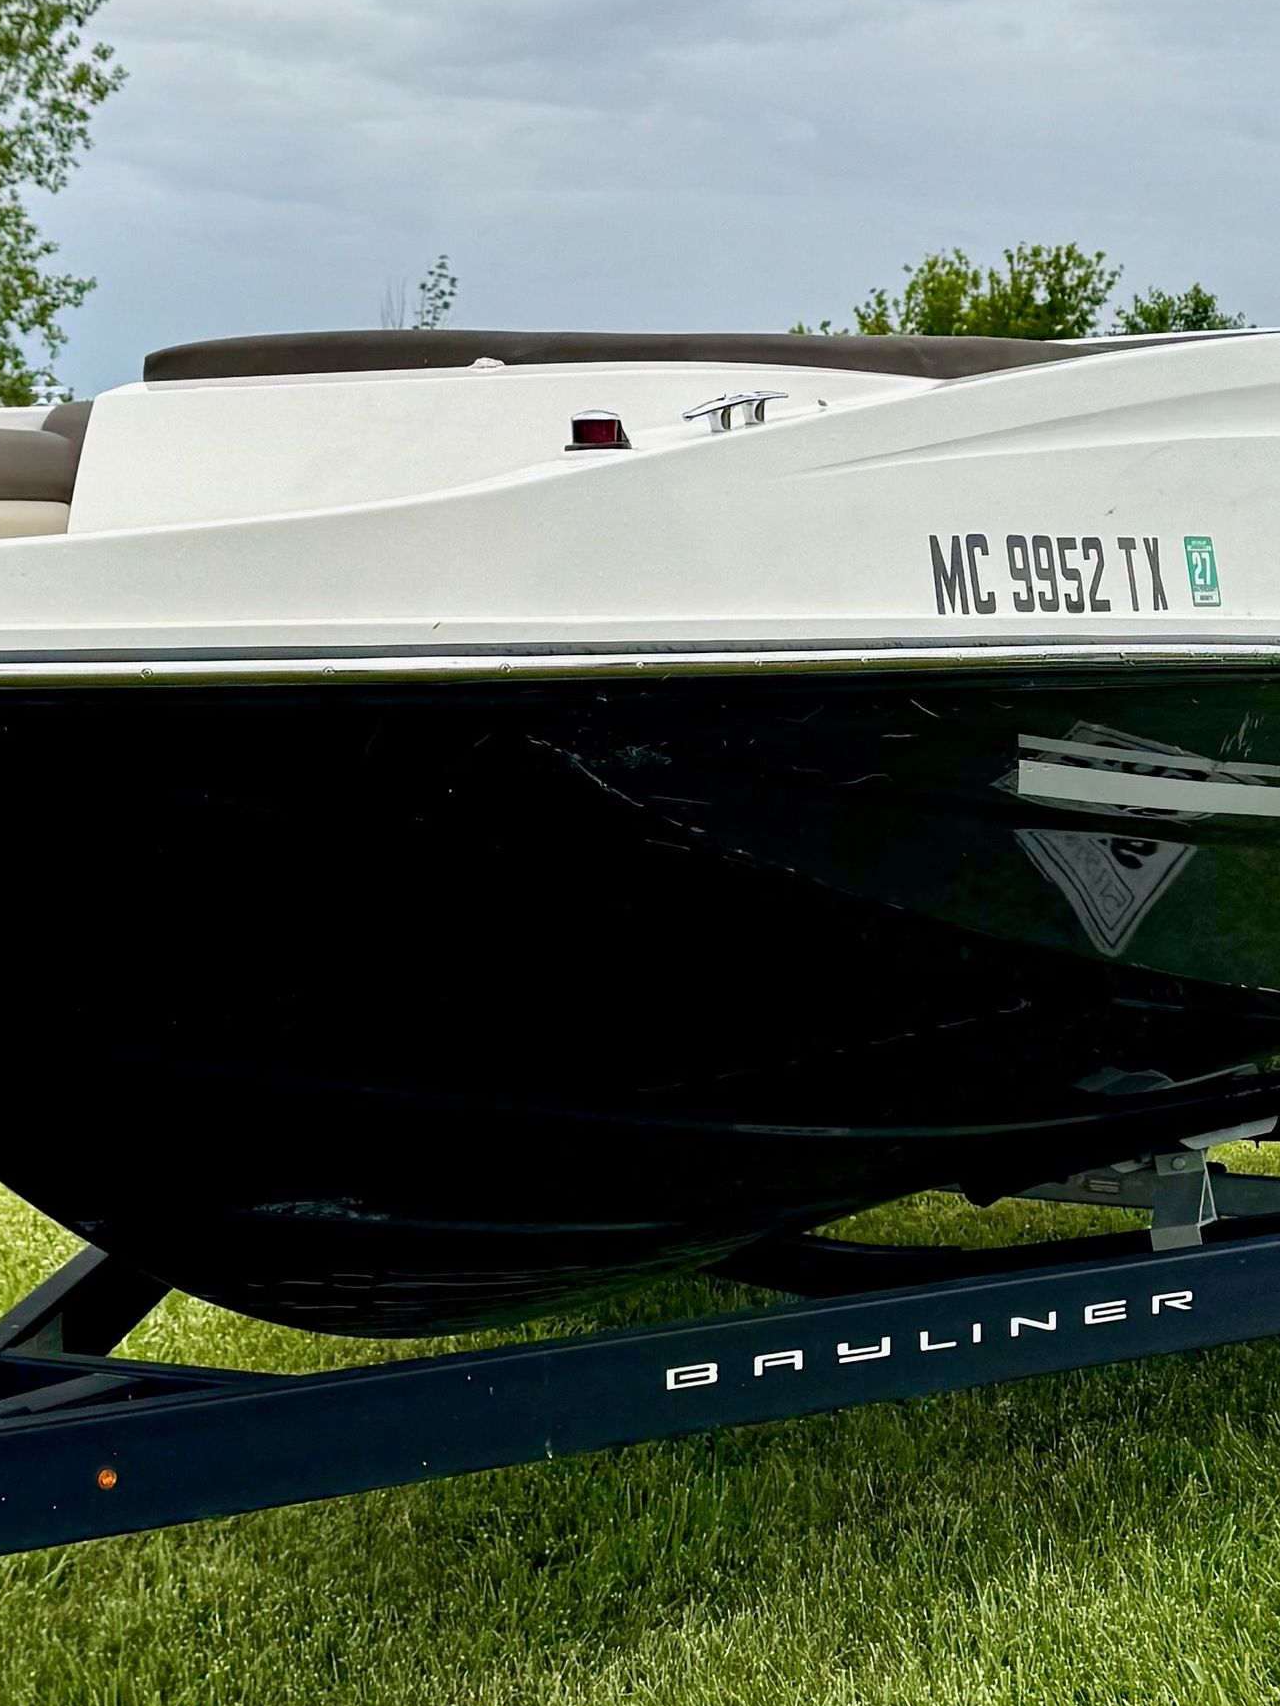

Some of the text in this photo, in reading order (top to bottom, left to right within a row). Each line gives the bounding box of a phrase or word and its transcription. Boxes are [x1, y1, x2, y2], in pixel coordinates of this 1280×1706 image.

[929, 533, 1169, 615] MC 9952 TX
[1191, 551, 1211, 586] 27
[665, 1290, 1194, 1391] BAYLINER
